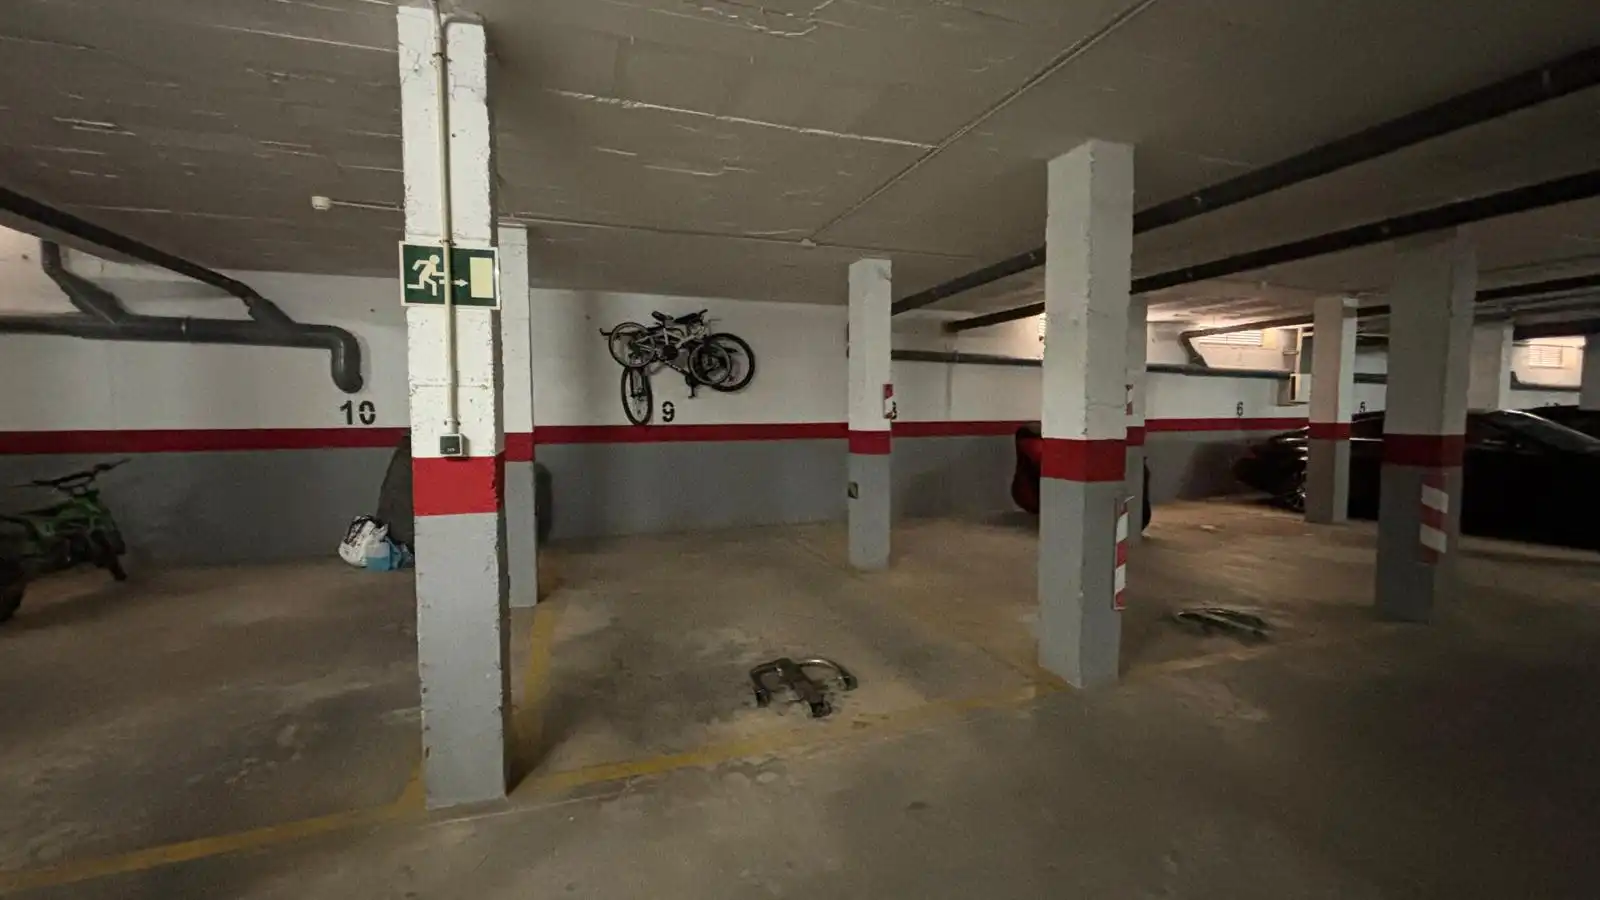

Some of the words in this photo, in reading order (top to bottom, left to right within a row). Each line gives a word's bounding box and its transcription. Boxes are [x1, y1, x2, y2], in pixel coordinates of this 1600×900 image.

[340, 400, 376, 425] 10
[662, 400, 675, 422] 9
[1236, 401, 1244, 417] 6
